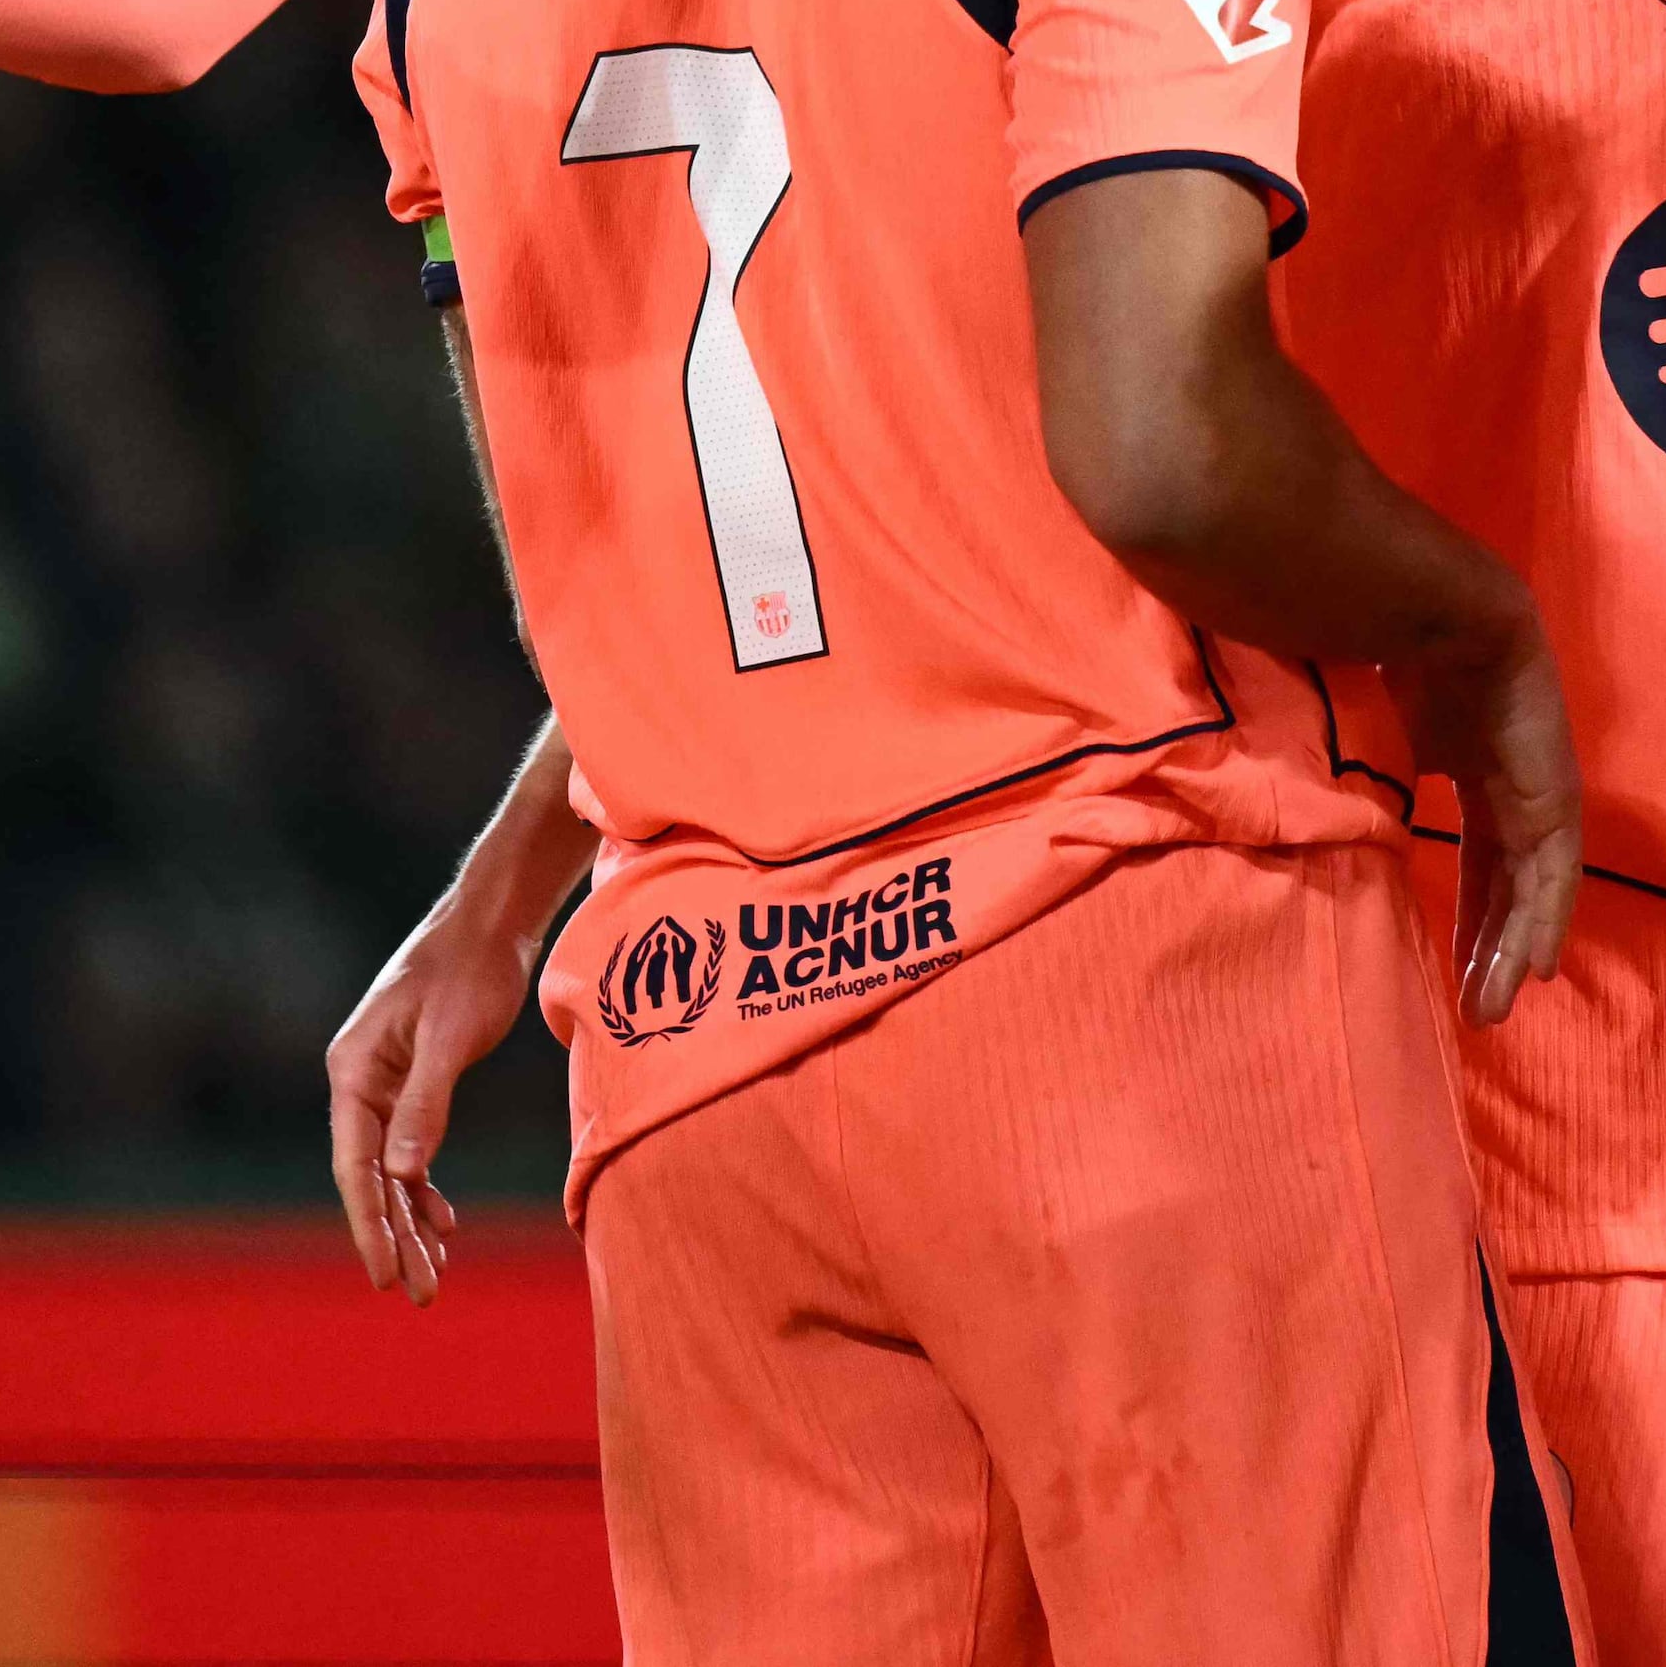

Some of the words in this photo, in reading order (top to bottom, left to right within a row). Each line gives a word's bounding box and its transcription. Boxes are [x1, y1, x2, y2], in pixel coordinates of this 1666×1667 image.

[560, 43, 831, 674] 7
[736, 898, 958, 1000] ACNUR
[739, 856, 952, 951] UNHCR
[737, 1001, 773, 1021] The
[777, 990, 806, 1012] UN
[810, 972, 888, 1004] Refugee
[893, 949, 964, 983] Agency
